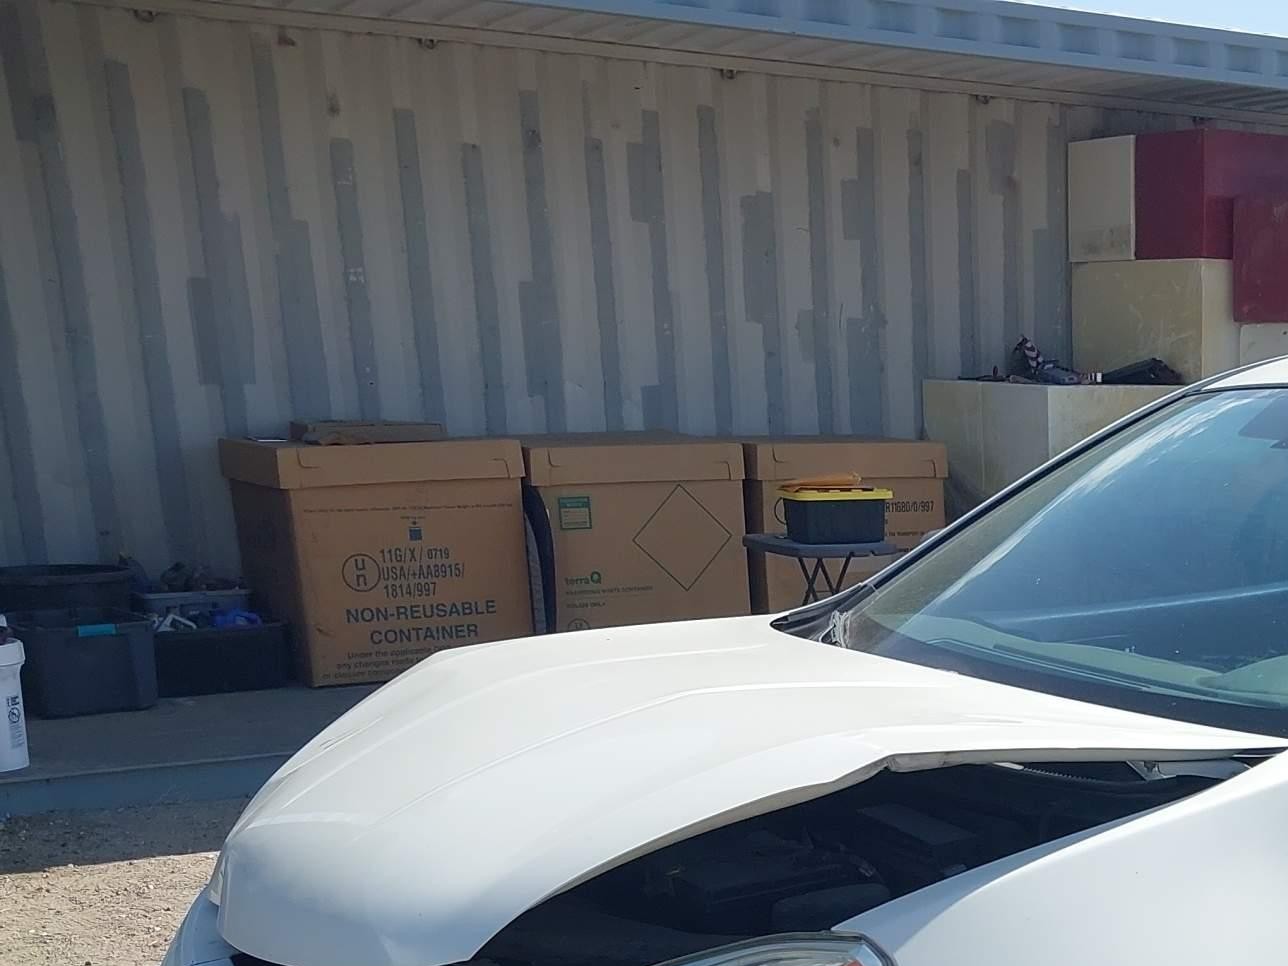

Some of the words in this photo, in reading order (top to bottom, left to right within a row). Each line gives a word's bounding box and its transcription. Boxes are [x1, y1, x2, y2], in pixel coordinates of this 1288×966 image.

[427, 547, 450, 561] 0719
[384, 582, 437, 599] 1814/997
[346, 600, 497, 623] NON-REUSABLE
[370, 624, 479, 645] CONTAINER
